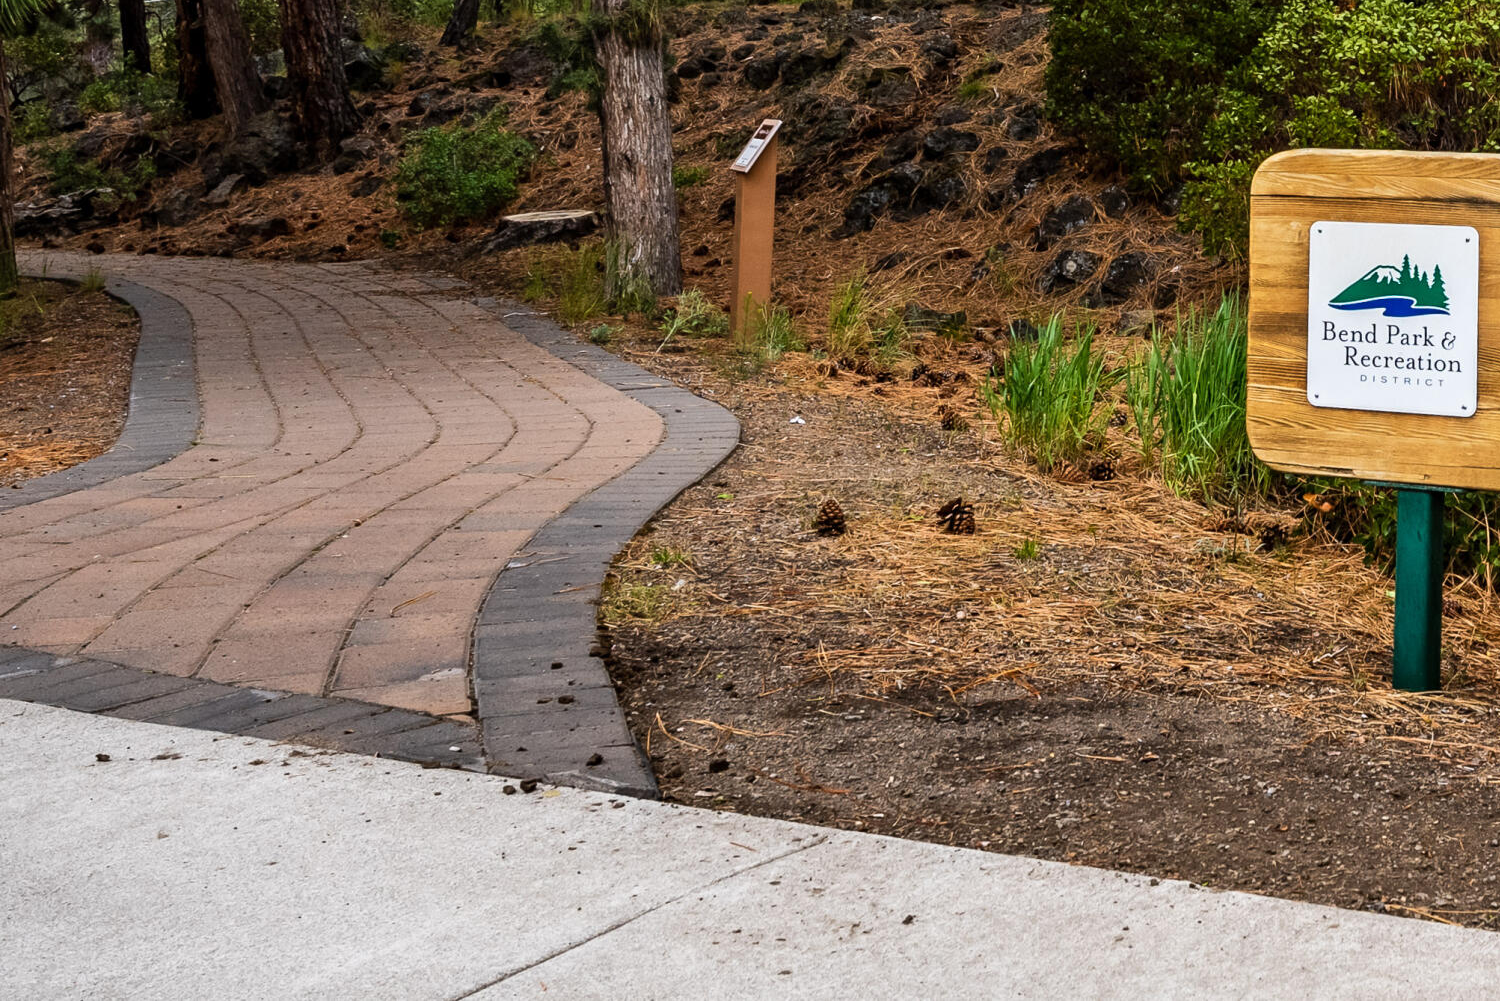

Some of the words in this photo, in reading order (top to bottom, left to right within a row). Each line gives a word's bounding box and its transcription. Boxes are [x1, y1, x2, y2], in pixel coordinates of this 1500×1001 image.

[1322, 321, 1377, 344] Bend
[1386, 324, 1435, 347] Park
[1441, 331, 1456, 350] &
[1344, 346, 1462, 373] Recreation
[1360, 374, 1444, 387] DISTRICT
